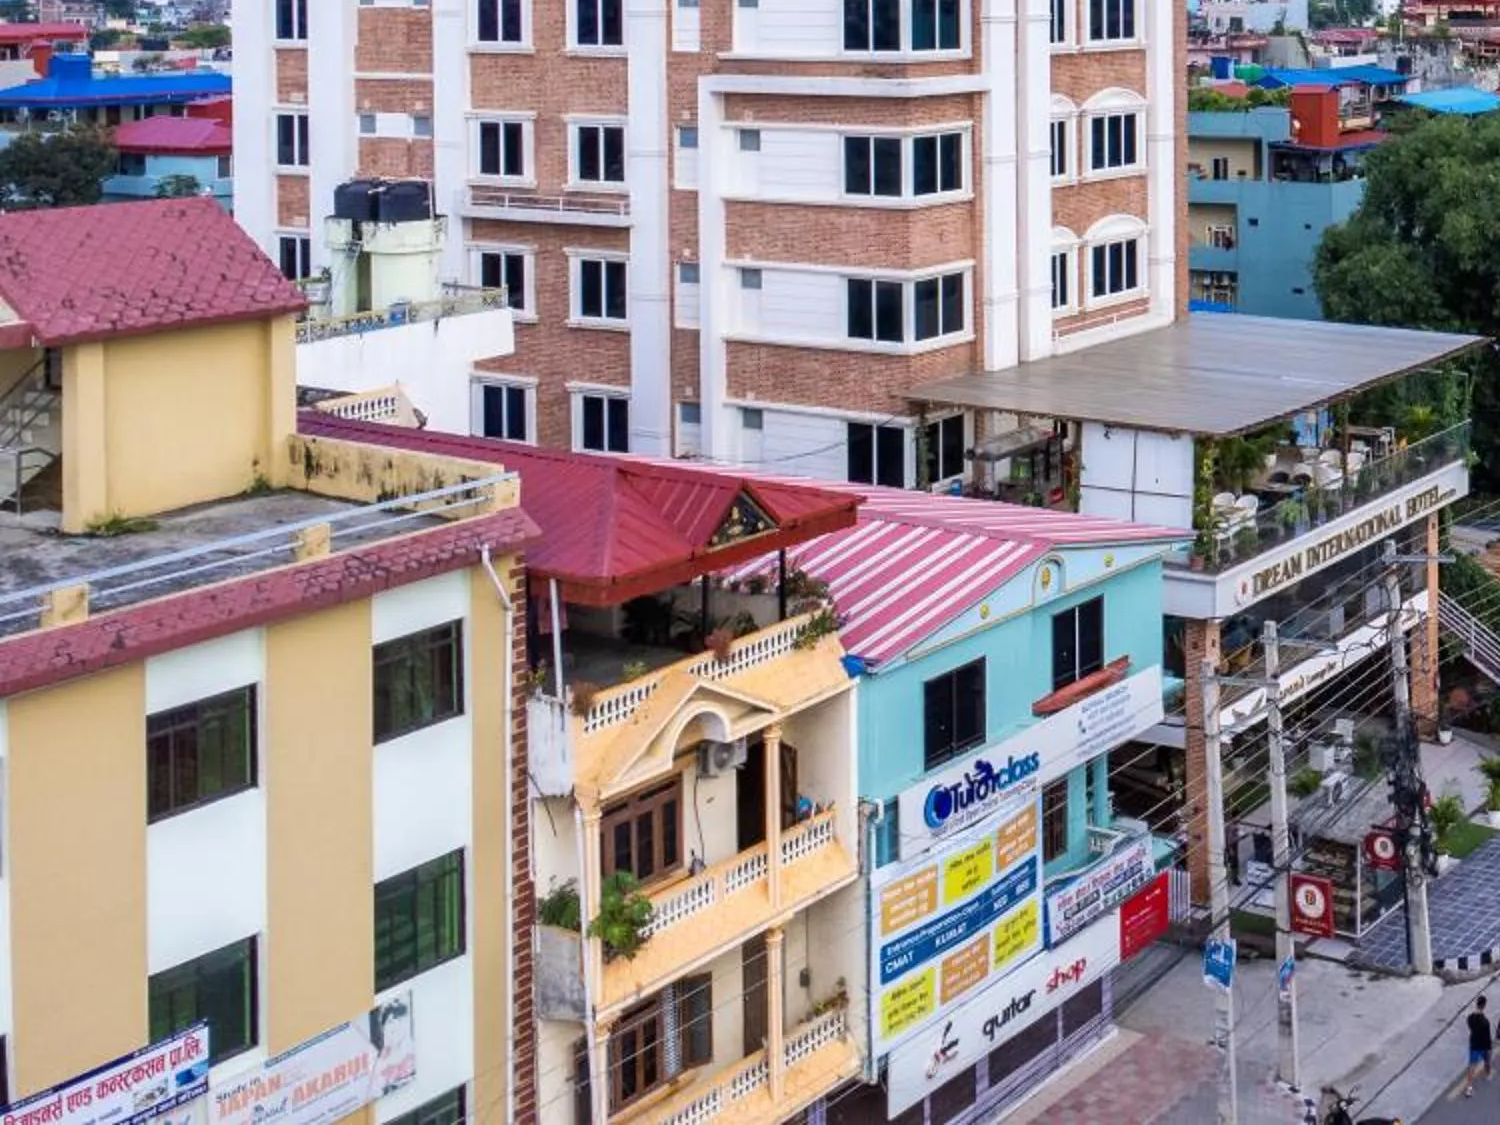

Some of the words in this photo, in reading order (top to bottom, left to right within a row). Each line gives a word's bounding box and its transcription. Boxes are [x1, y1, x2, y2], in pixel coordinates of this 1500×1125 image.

[1253, 554, 1302, 597] DREAM
[1306, 505, 1401, 569] INTERNATIONAL
[1406, 485, 1439, 518] HOTEL
[982, 988, 1037, 1042] guitar
[1046, 957, 1087, 995] shop
